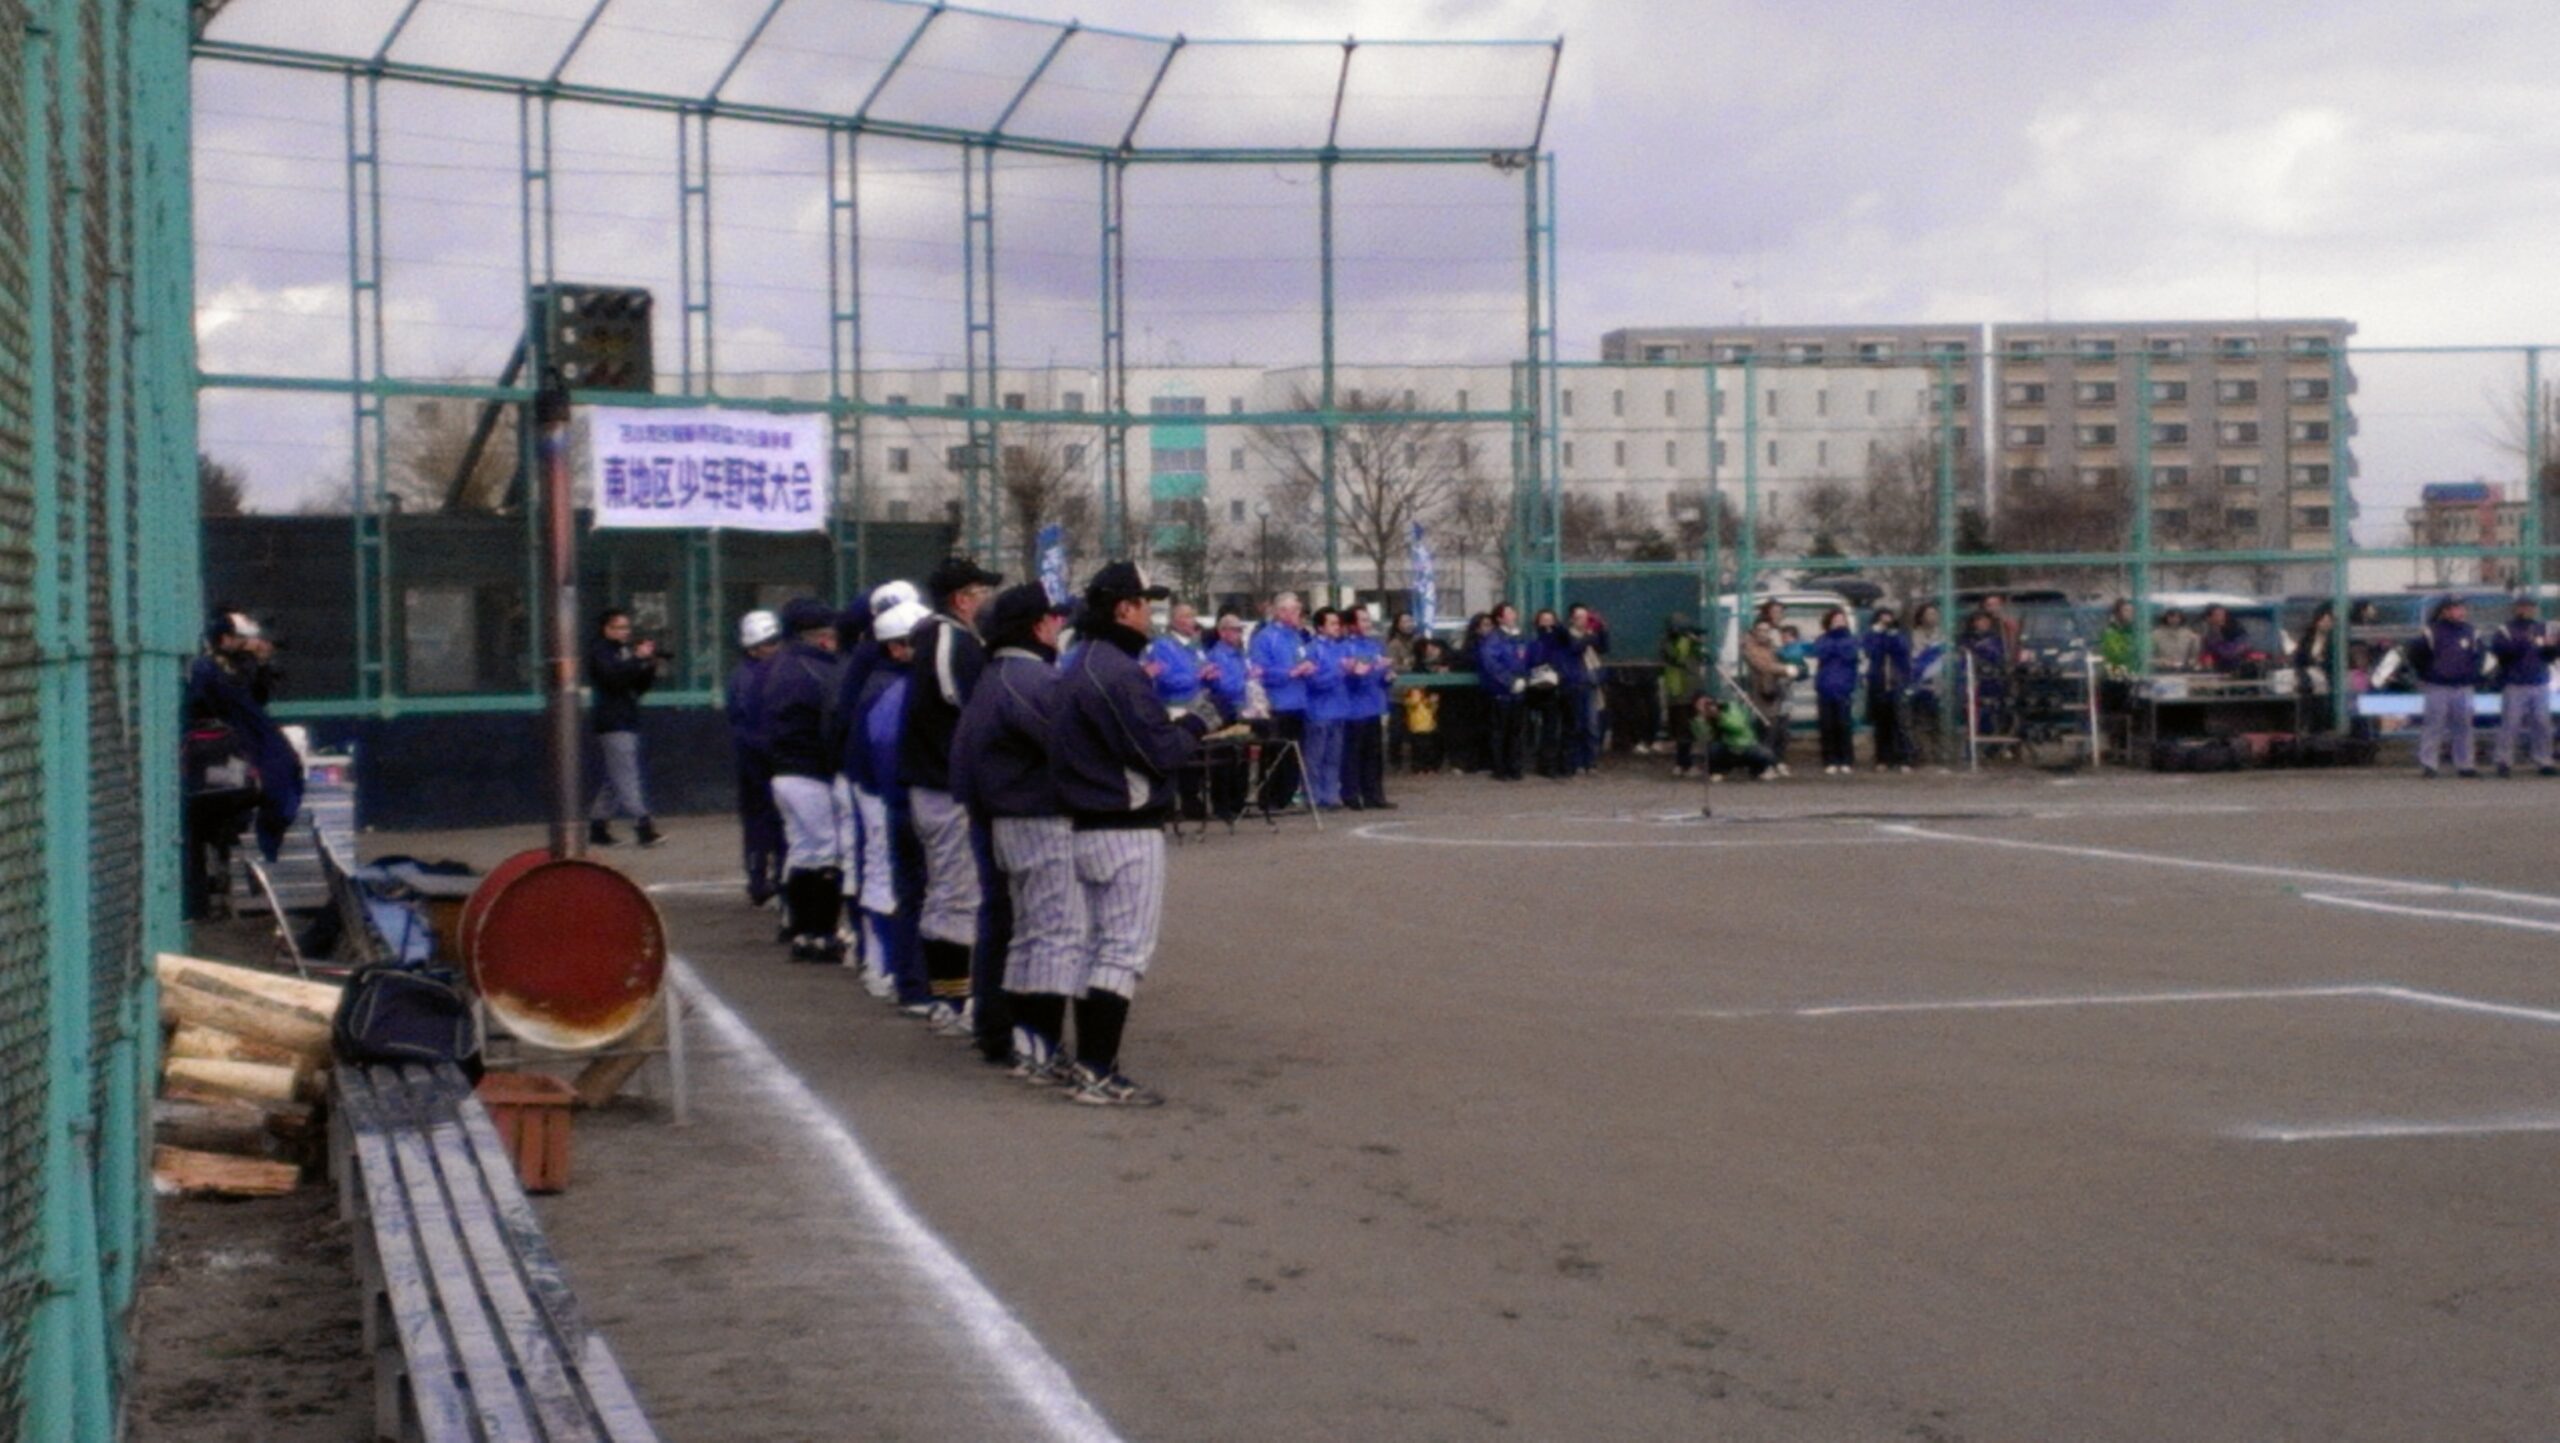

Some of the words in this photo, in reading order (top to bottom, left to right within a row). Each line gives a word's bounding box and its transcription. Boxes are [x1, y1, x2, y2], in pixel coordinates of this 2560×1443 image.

[604, 456, 811, 512] 東地区少年野球大会
